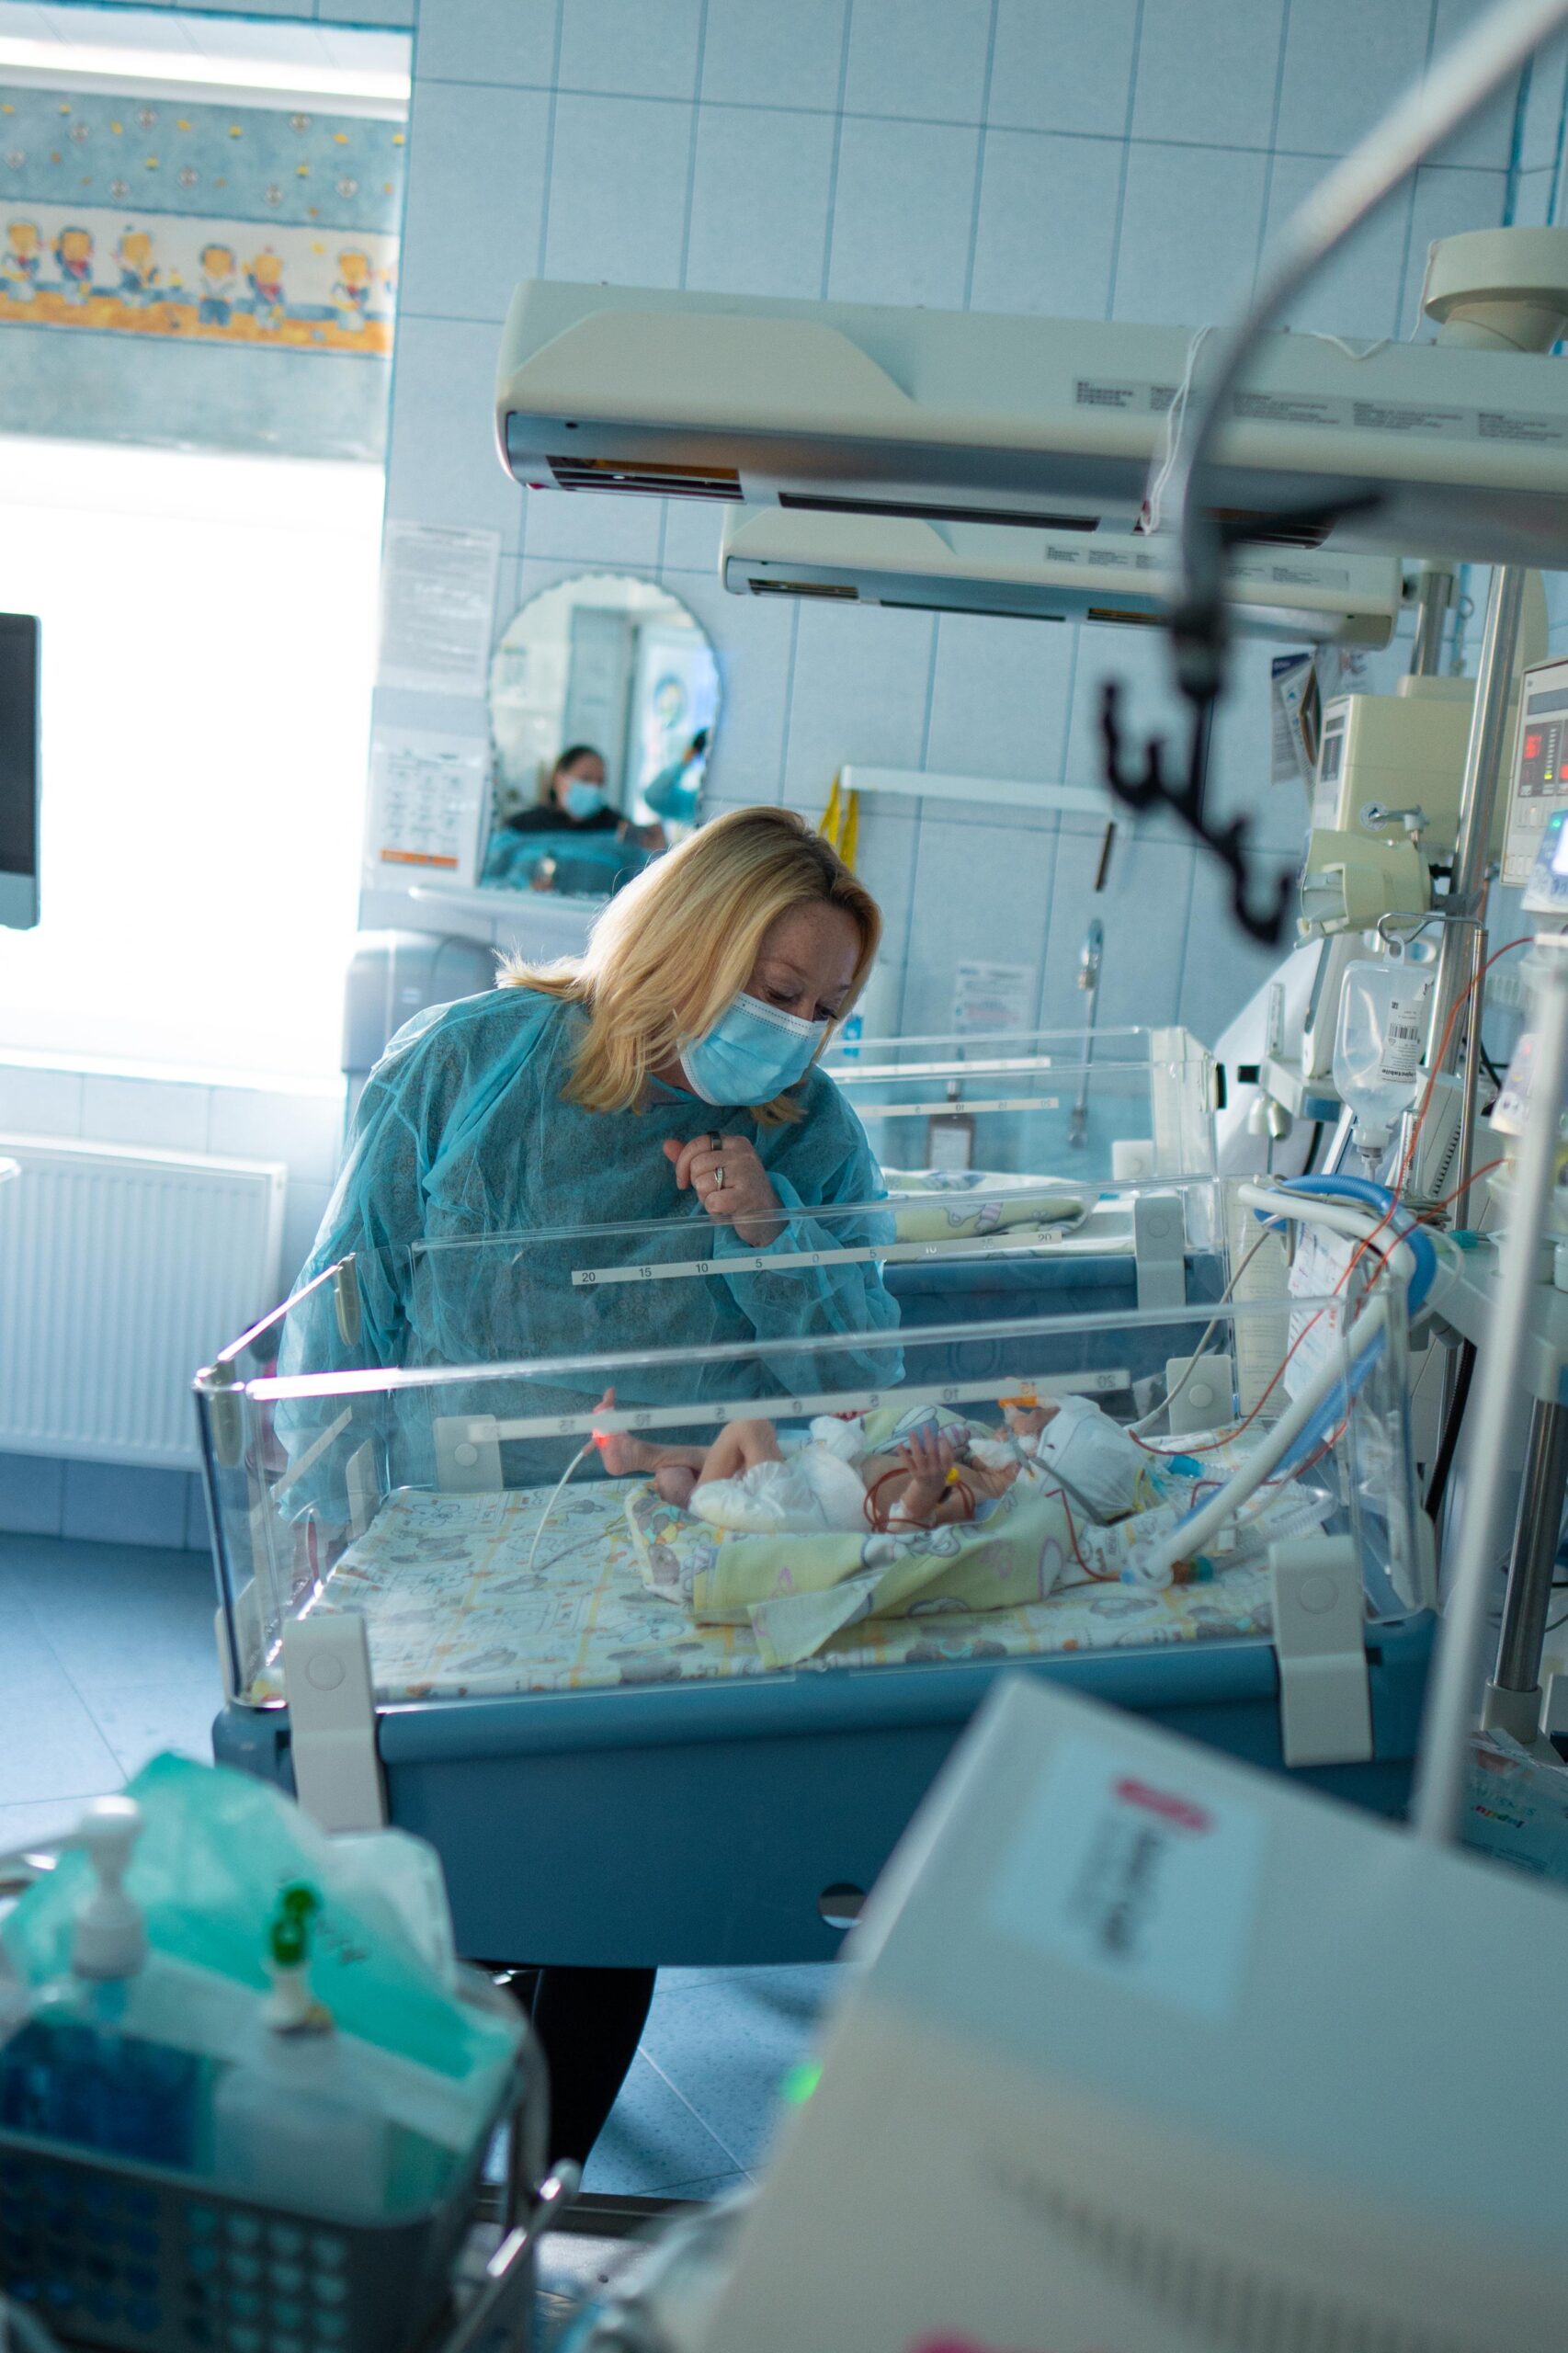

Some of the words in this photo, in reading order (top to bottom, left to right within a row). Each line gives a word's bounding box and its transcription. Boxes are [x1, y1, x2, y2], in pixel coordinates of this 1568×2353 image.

[582, 1272, 597, 1282] 20
[639, 1267, 653, 1278] 15
[696, 1263, 709, 1273] 10
[756, 1258, 763, 1268] 5
[812, 1254, 820, 1264] 0
[870, 1249, 877, 1258] 5
